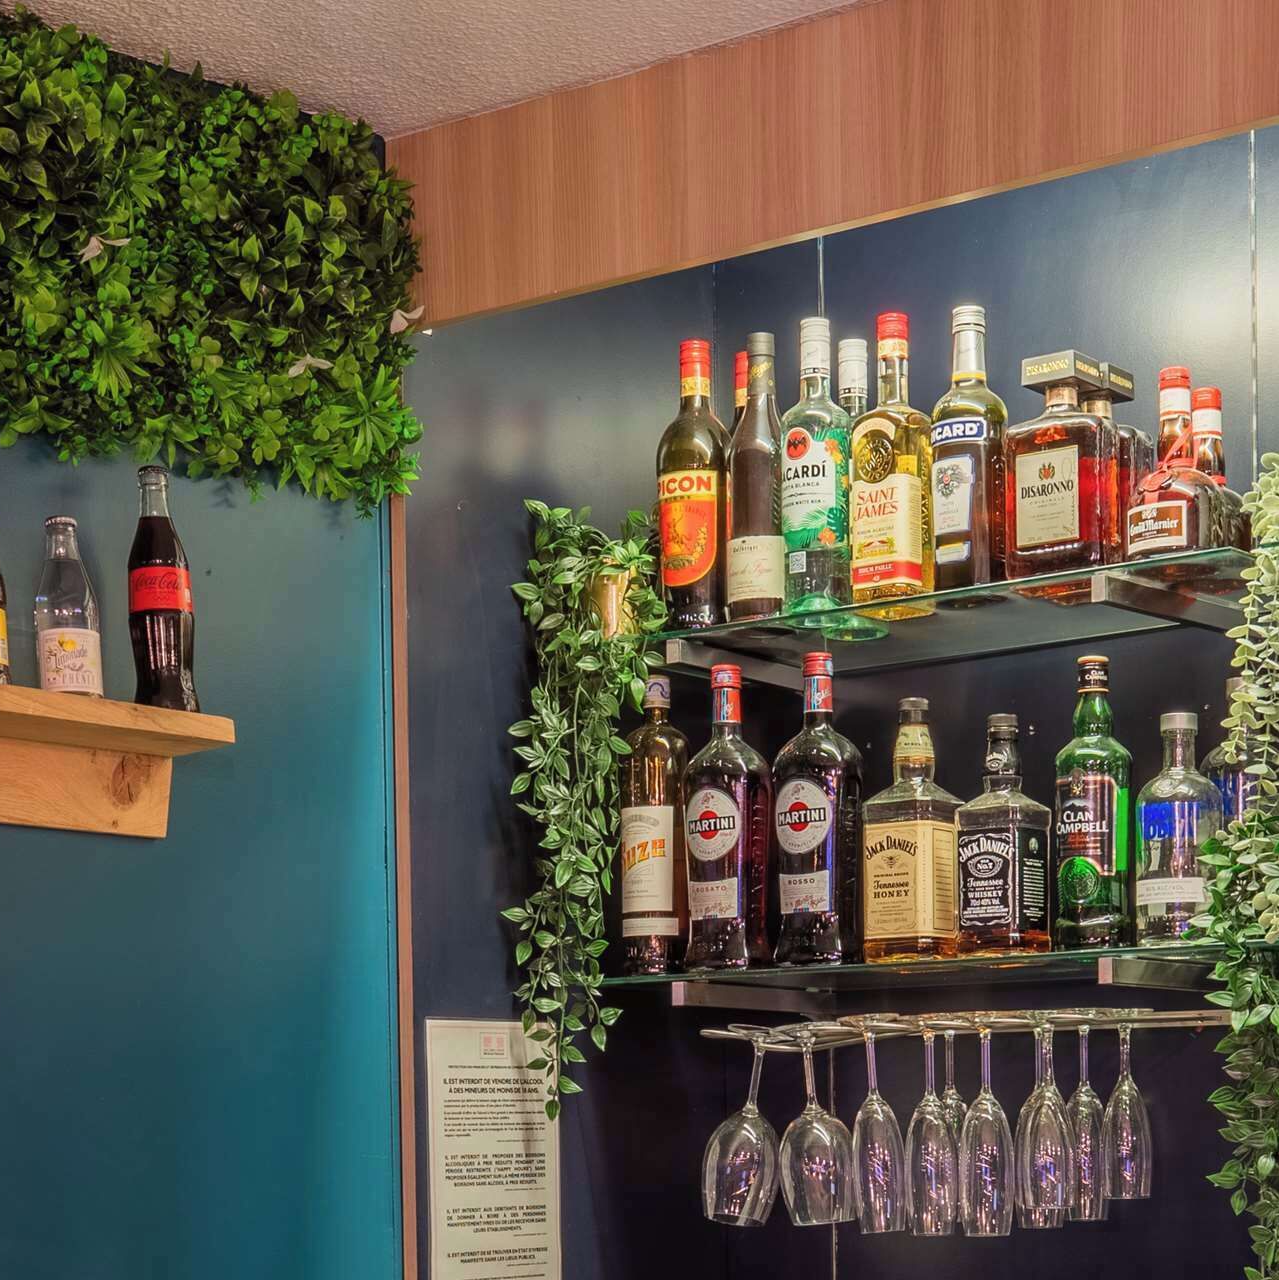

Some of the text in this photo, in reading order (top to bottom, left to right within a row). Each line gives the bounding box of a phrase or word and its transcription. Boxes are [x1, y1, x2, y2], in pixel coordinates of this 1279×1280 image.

[857, 486, 899, 504] SAINT
[1021, 480, 1074, 500] DISARONNO
[854, 501, 899, 522] JAMES
[778, 809, 825, 826] MARTINI
[1063, 810, 1094, 823] CLAN
[689, 817, 734, 834] MARTINI
[1056, 822, 1109, 835] CAMPBELL
[865, 835, 919, 861] JACK DANIEL'S
[959, 837, 1016, 863] JACK DANIEL'S
[696, 885, 727, 893] ROSATO
[873, 880, 910, 891] Tennessee
[967, 878, 1004, 888] Tennessee
[873, 889, 910, 899] HONEY
[967, 890, 1003, 898] WHISKEY
